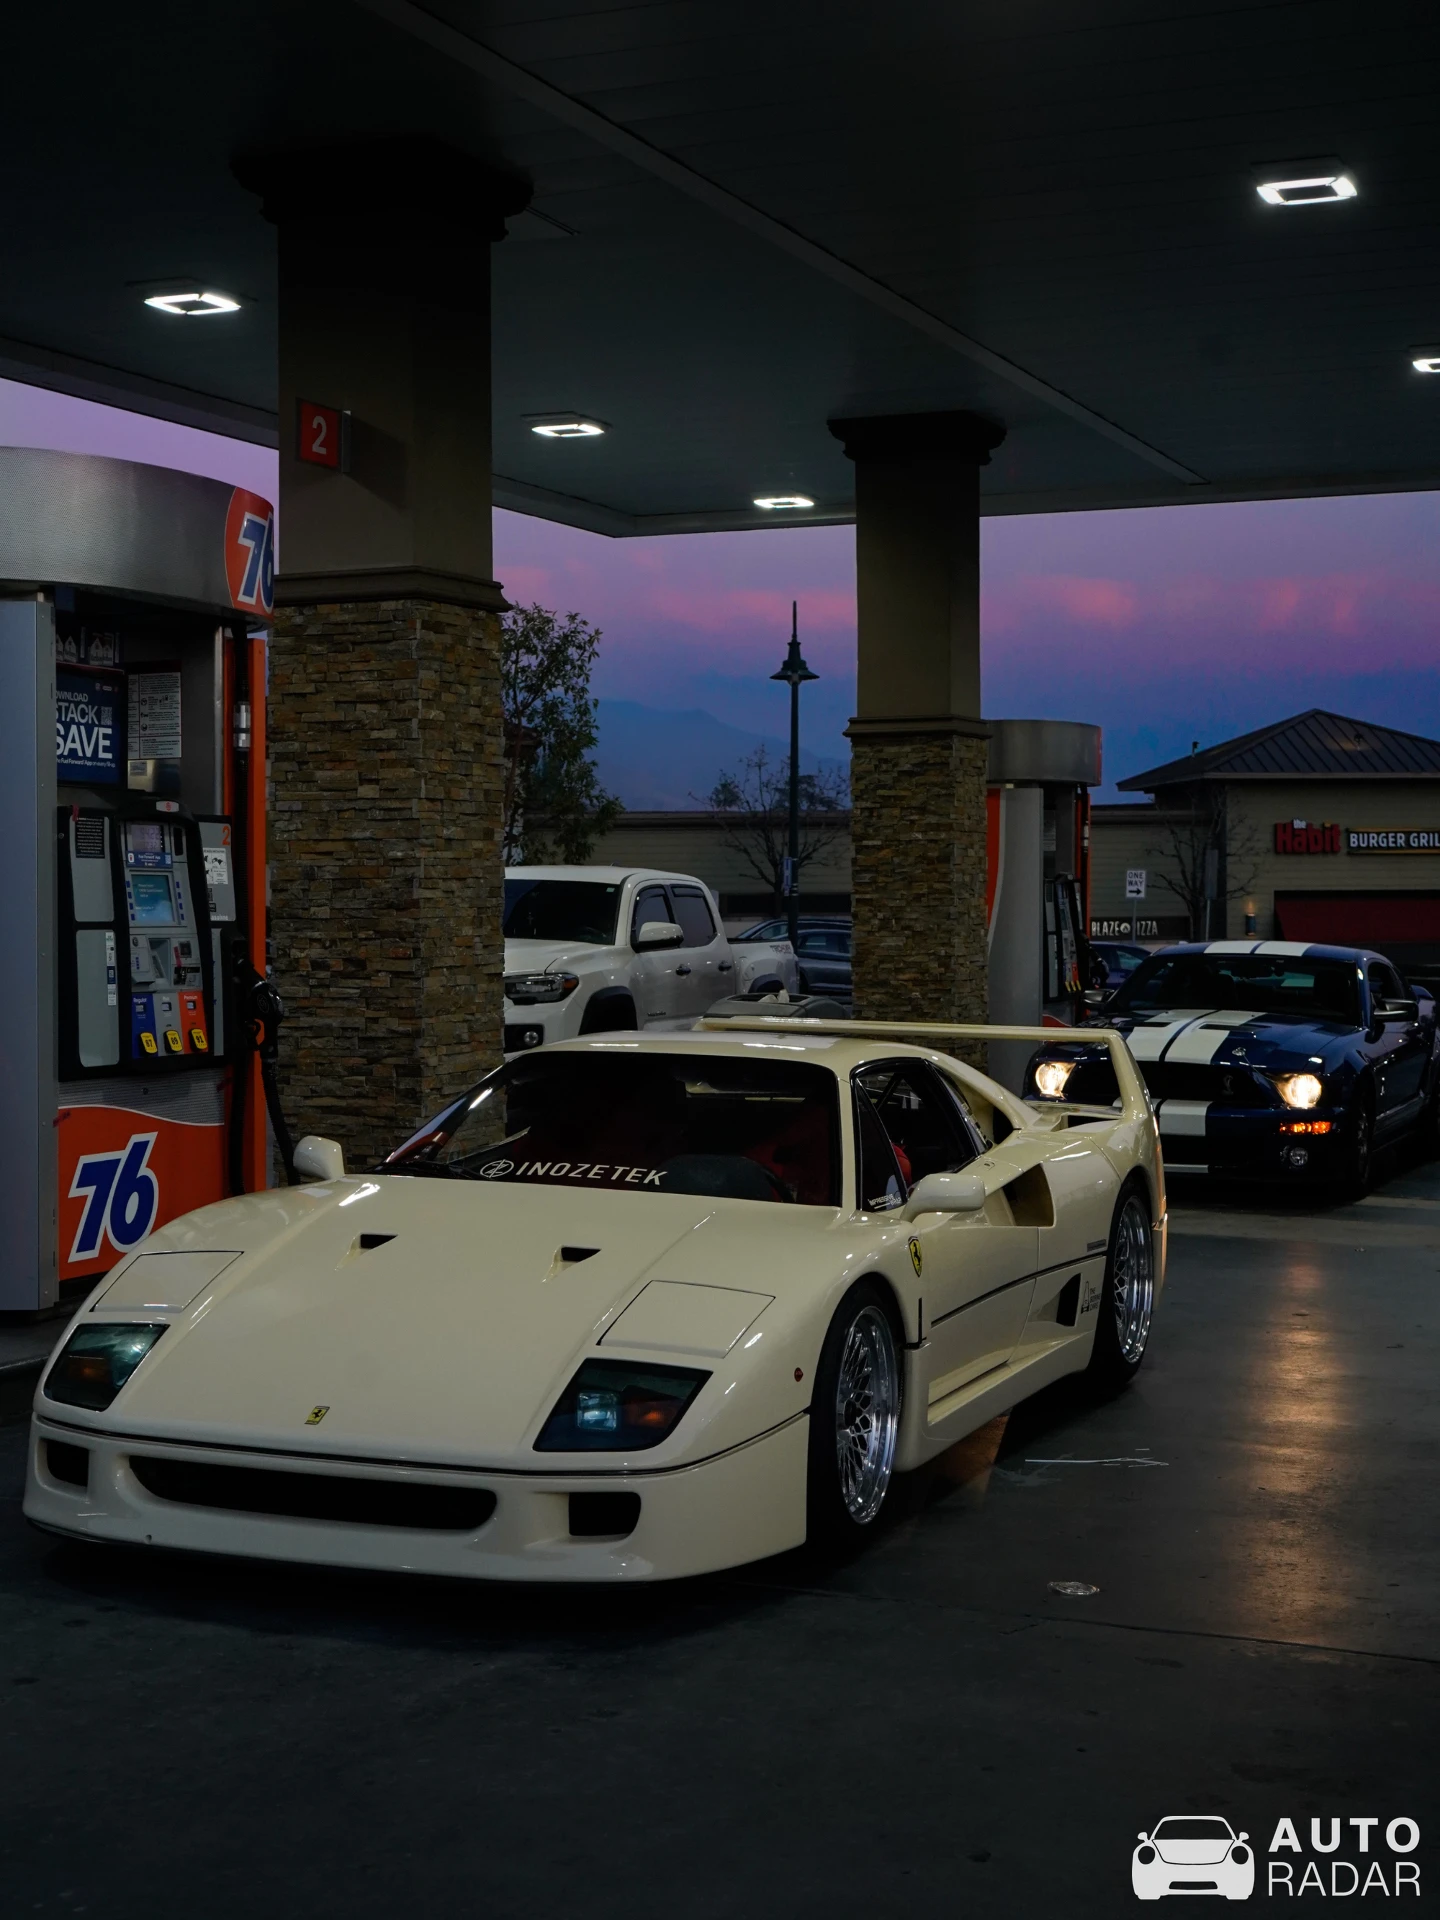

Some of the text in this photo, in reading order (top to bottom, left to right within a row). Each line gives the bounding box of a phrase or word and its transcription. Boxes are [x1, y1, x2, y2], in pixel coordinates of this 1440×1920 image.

[311, 415, 327, 455] 2
[56, 702, 99, 725] TACK
[1292, 819, 1306, 829] the
[222, 826, 230, 846] 2
[1275, 822, 1340, 854] Habit
[1349, 832, 1405, 848] BURGER
[1091, 920, 1159, 936] BLAZE IZZA
[170, 1036, 179, 1045] 89
[195, 1035, 204, 1043] 91
[515, 1161, 668, 1186] INOZETEK
[68, 1131, 159, 1263] 76
